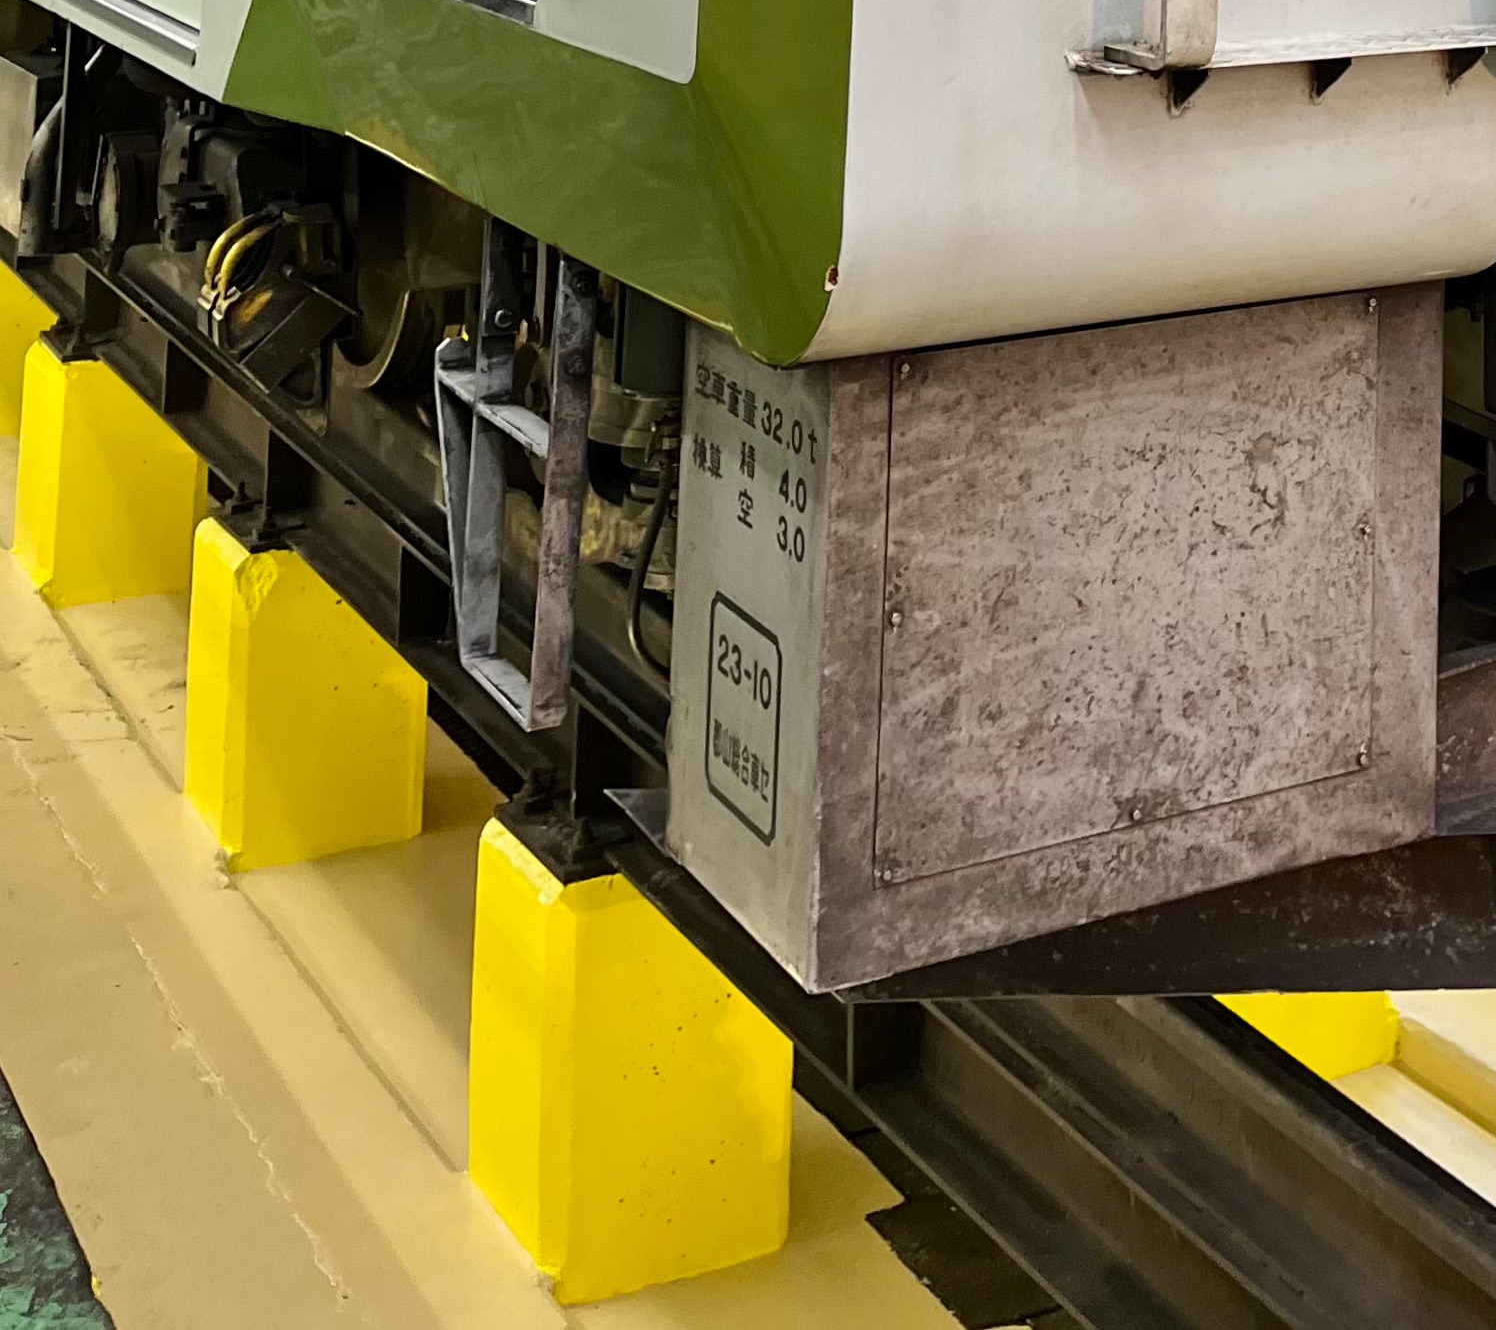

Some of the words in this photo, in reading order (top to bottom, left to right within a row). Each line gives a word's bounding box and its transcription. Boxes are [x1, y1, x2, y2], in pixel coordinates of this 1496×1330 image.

[737, 487, 754, 529] 空
[776, 515, 806, 562] 3.0
[778, 469, 807, 514] 4.0
[717, 634, 772, 710] 23-10
